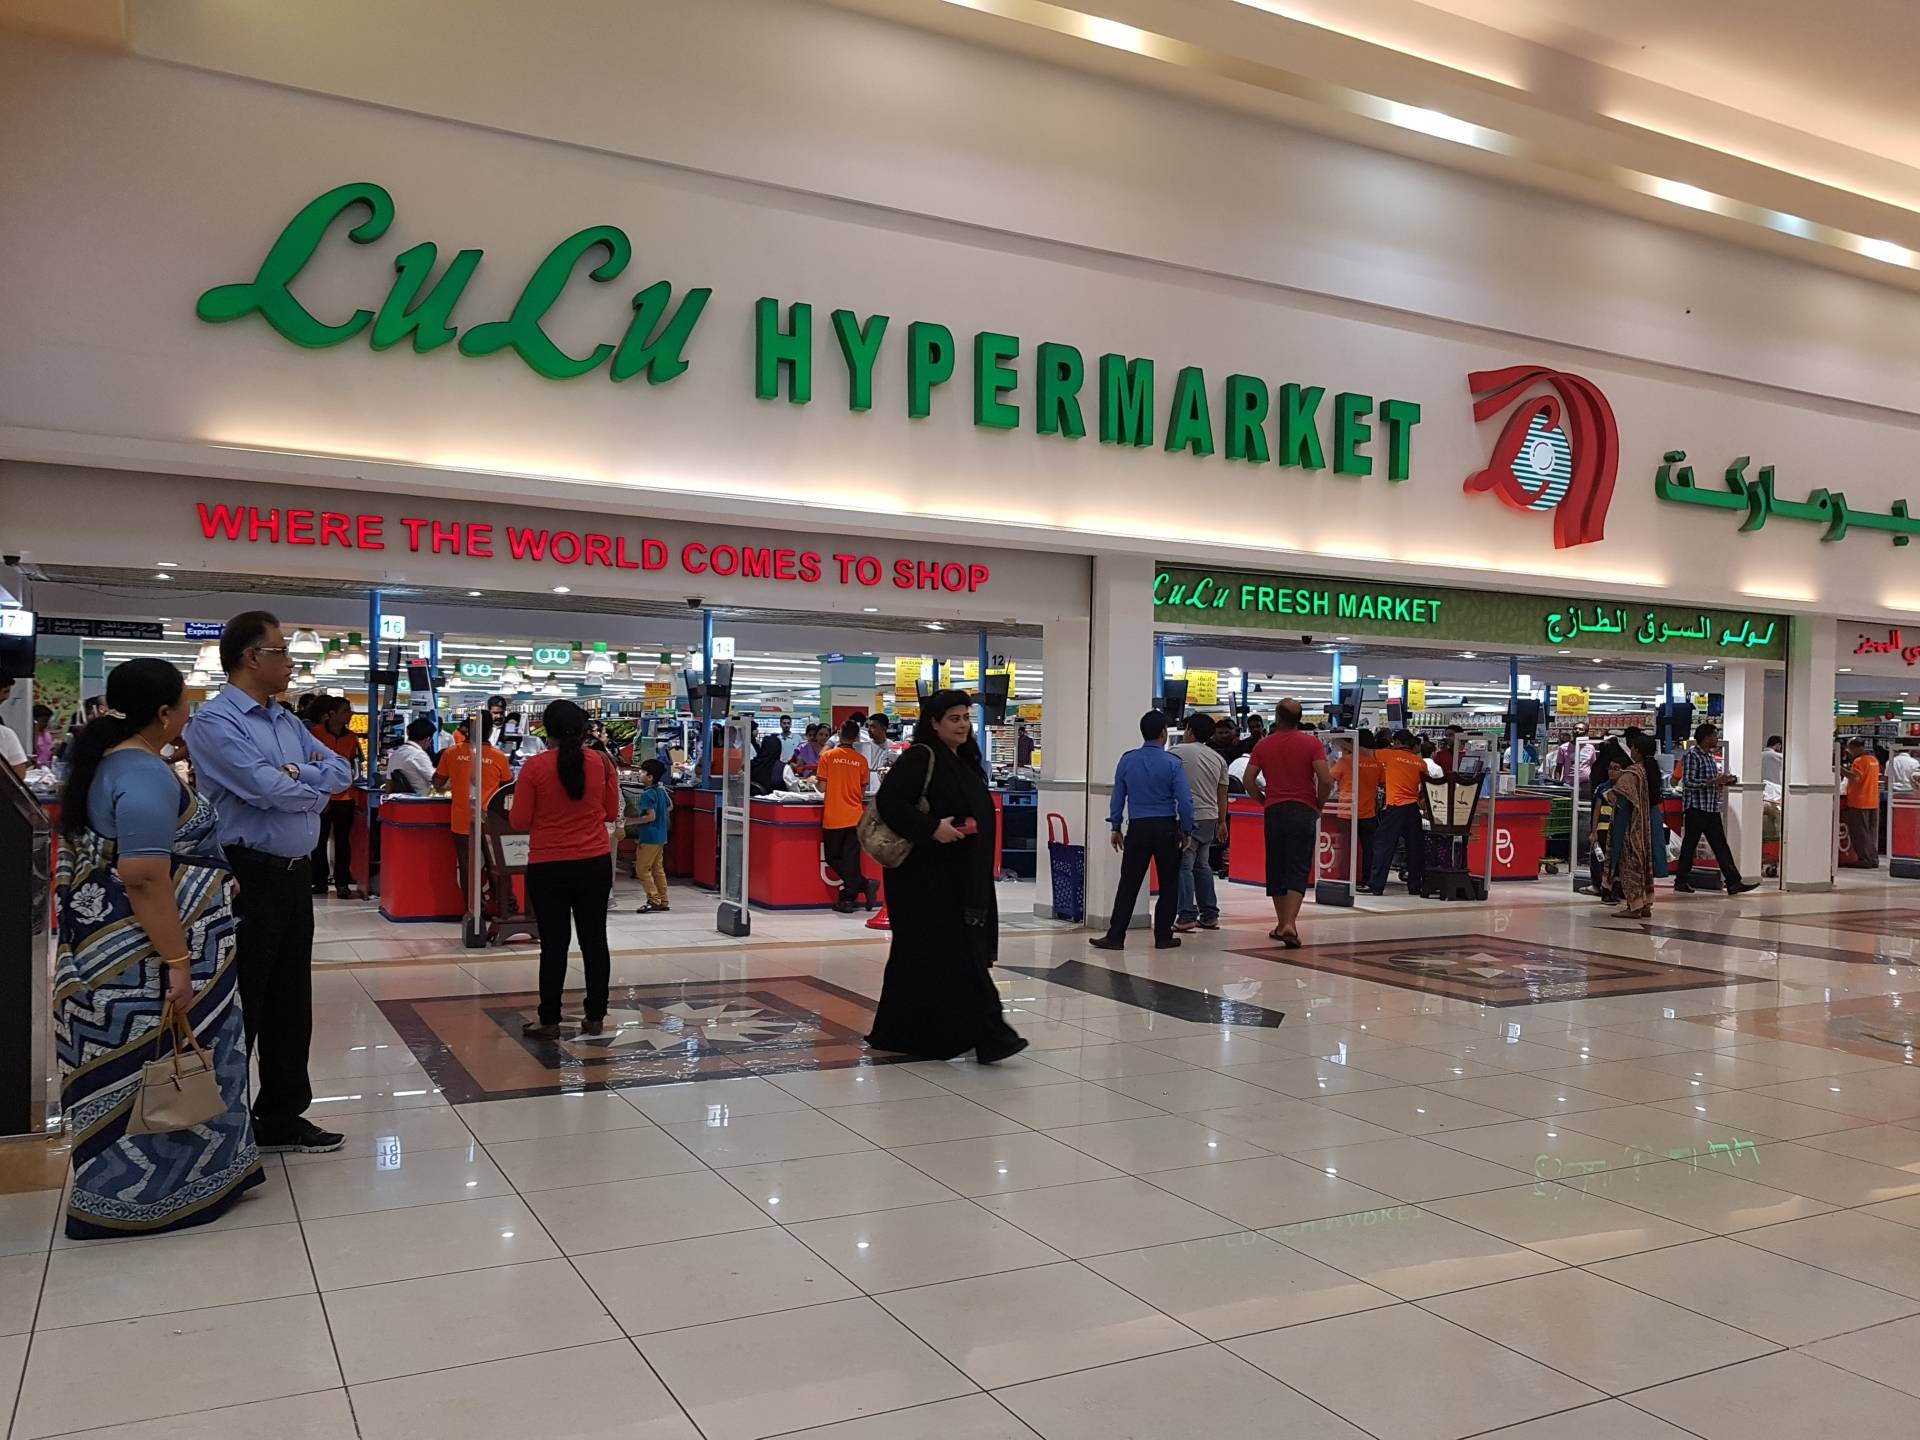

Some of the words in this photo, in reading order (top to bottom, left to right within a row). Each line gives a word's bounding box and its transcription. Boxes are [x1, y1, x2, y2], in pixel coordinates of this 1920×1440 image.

[196, 182, 712, 385] LuLu
[754, 296, 1421, 482] HYPERMARKET
[196, 502, 385, 550] WHERE
[400, 518, 494, 558] THE
[506, 526, 669, 571] WORLD
[680, 542, 822, 583] COMES
[833, 553, 883, 587] TO
[892, 559, 990, 593] SHOP
[1152, 572, 1230, 609] LuLu
[1240, 585, 1330, 616] FRESH
[1337, 593, 1442, 624] MARKET
[187, 627, 220, 637] Express
[383, 620, 402, 634] 16
[1545, 606, 1628, 644] الطازج
[1636, 611, 1712, 644] السوق
[1719, 619, 1777, 648] لولو
[991, 655, 1005, 666] 12
